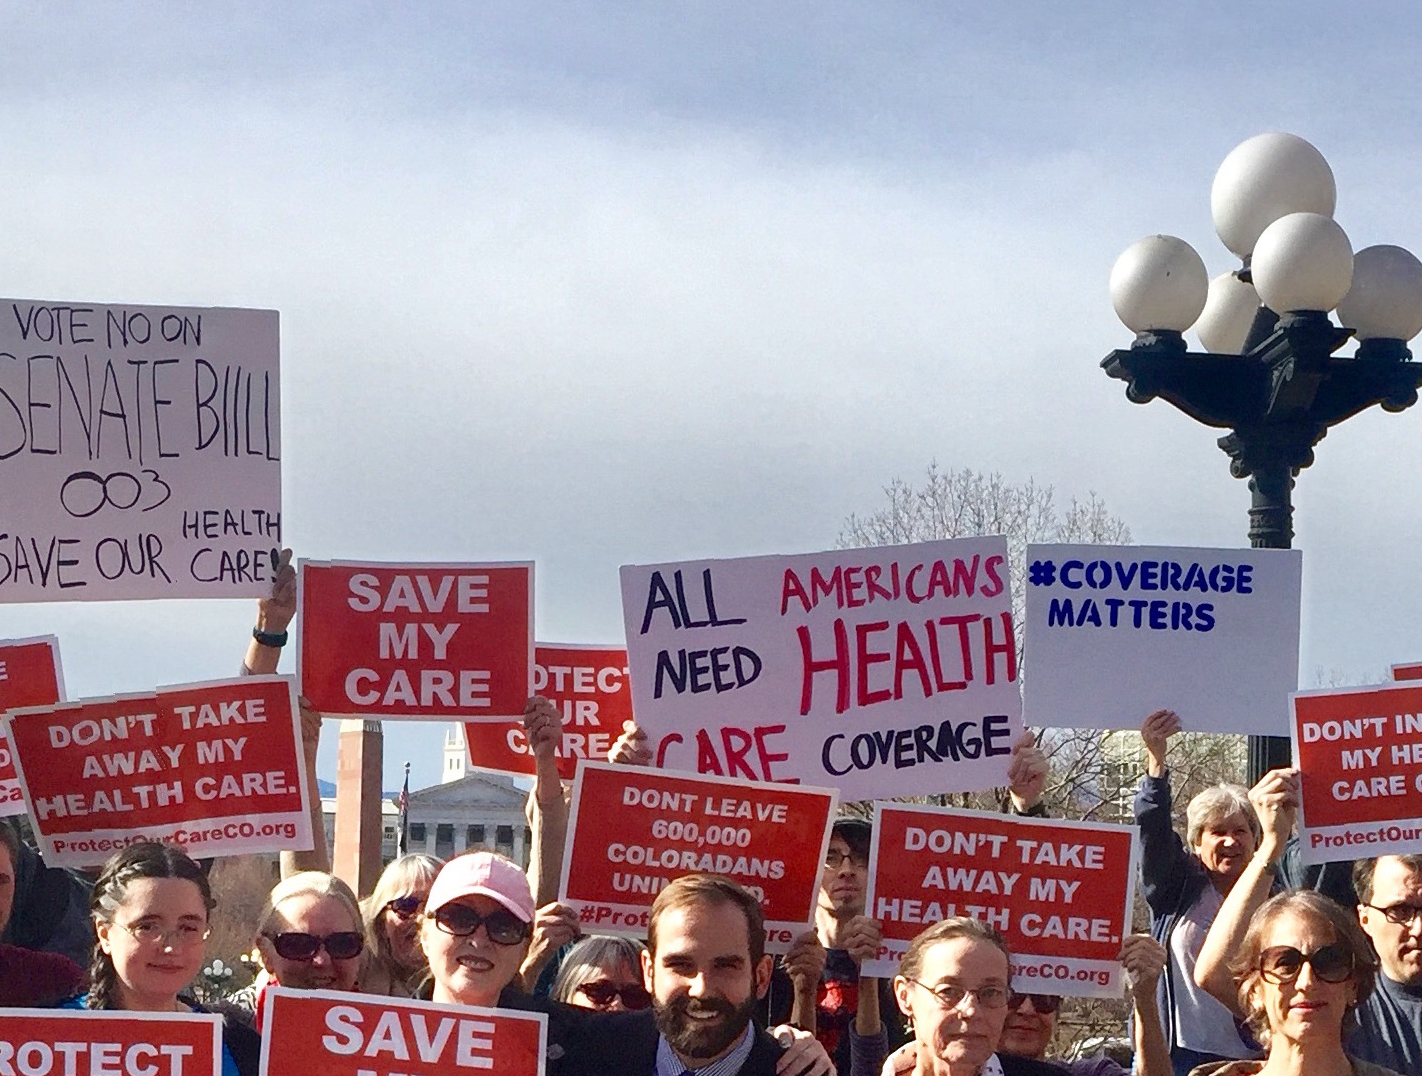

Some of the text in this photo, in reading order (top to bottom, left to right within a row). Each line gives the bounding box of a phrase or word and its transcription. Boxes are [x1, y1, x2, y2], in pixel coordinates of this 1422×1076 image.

[13, 304, 202, 349] VOTE NO ON
[60, 469, 172, 517] 003
[182, 508, 281, 543] HEALTH
[95, 533, 172, 584] OUR
[1029, 560, 1254, 594] #COVERAGE
[347, 573, 490, 613] SAVE
[640, 553, 1005, 635] ALL AMERICANS
[1048, 598, 1216, 632] MATTERS
[379, 622, 460, 660] MY
[534, 664, 630, 694] OTEC
[653, 610, 1017, 716] NEED HEALTH
[344, 668, 491, 707] CARE
[48, 698, 266, 748] DON'T TAKE
[548, 699, 601, 726] UR
[1302, 716, 1387, 743] DON'T
[82, 736, 248, 779] AWAY MY
[821, 715, 1011, 776] COVERAGE
[1341, 747, 1383, 770] MY
[36, 770, 297, 821] HEALTH CARE.
[622, 786, 789, 824] DONT LEAVE
[1332, 775, 1407, 801] CARE
[651, 819, 752, 848] 600,000
[904, 826, 1106, 870] DON'T TAKE
[607, 843, 786, 880] COLORADANS
[921, 865, 1082, 905] AWAY MY
[1020, 912, 1120, 944] CARE.
[322, 1005, 496, 1070] SAVE
